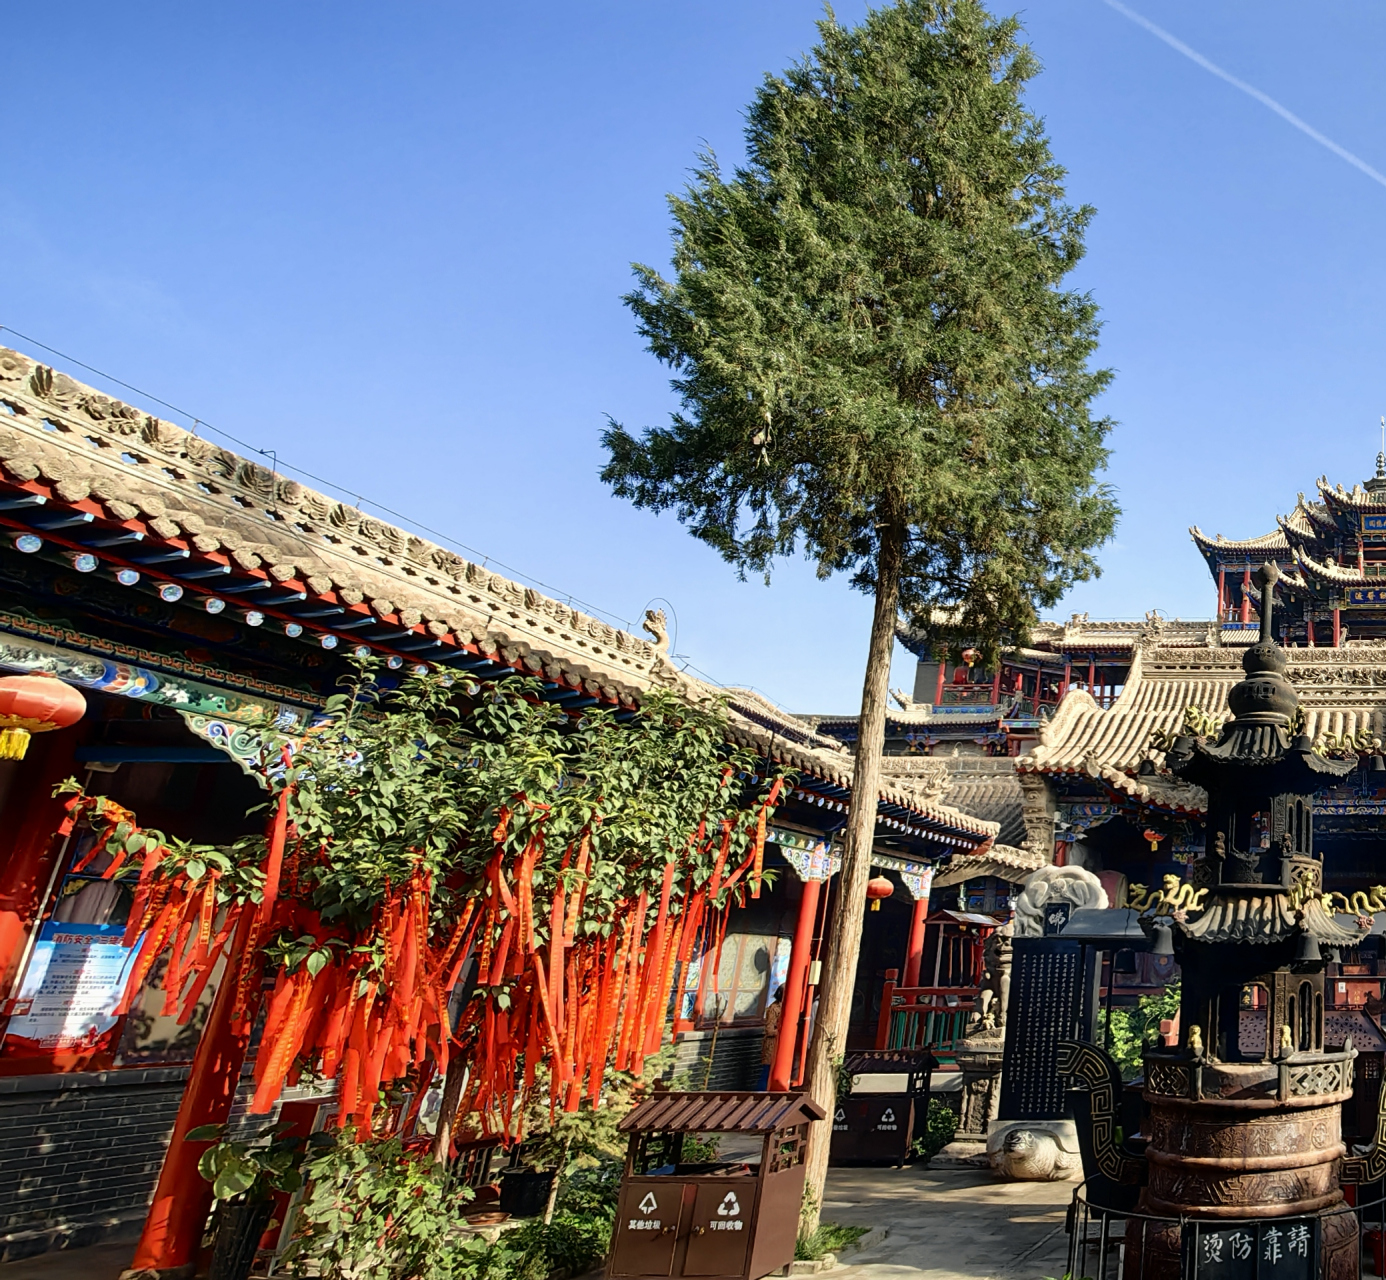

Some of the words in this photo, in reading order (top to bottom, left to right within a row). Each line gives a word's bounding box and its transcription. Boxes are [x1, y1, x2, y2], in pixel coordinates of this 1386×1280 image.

[628, 1219, 661, 1230] 其他垃圾
[710, 1220, 743, 1231] 可回收物
